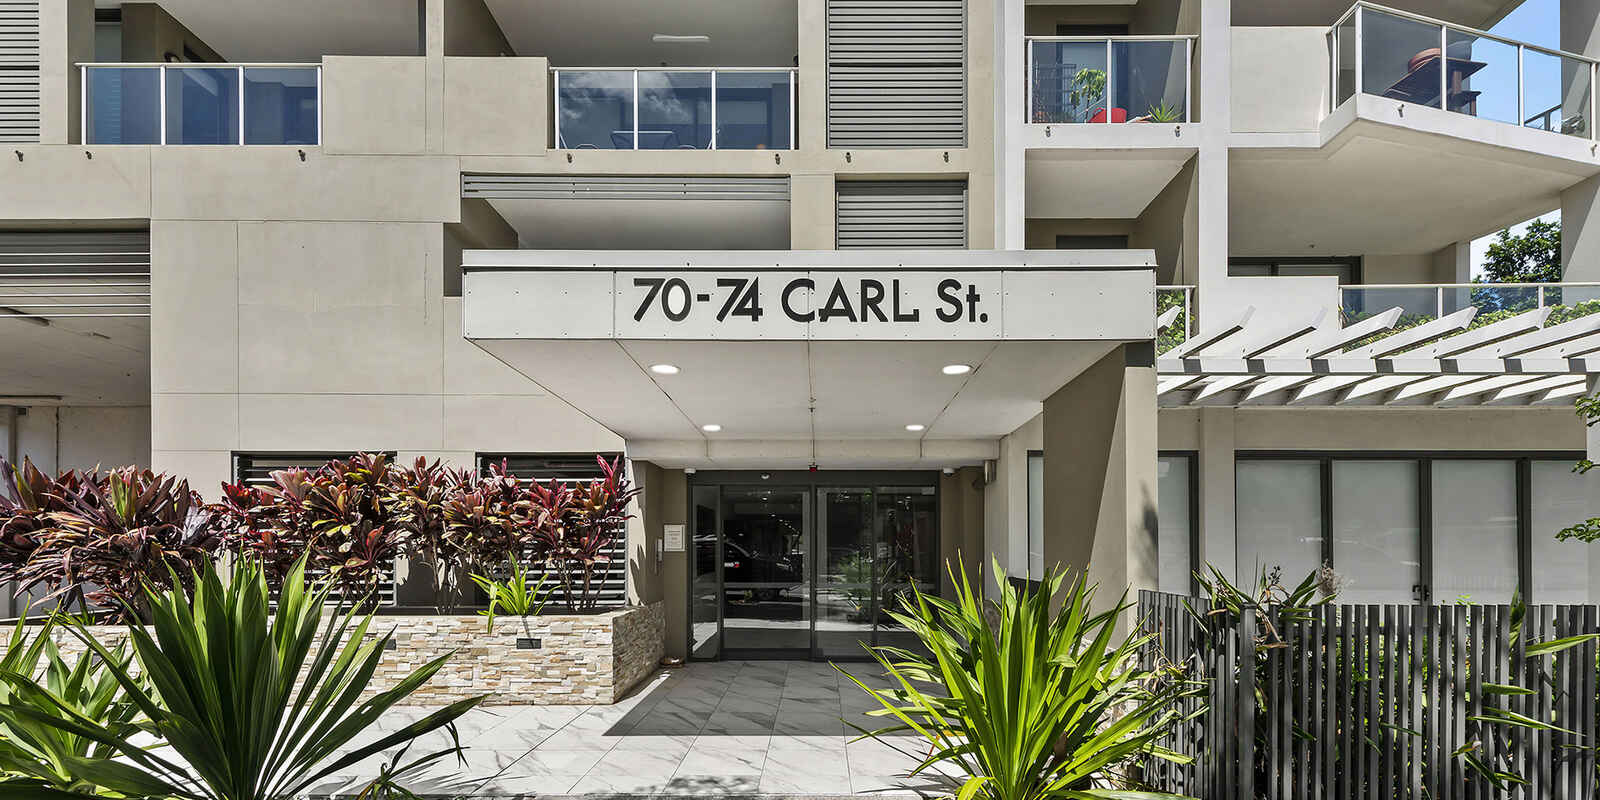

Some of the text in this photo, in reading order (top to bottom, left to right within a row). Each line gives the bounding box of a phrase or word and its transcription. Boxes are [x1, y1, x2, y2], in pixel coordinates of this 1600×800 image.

[633, 277, 989, 323] 70-74 CARL St.
